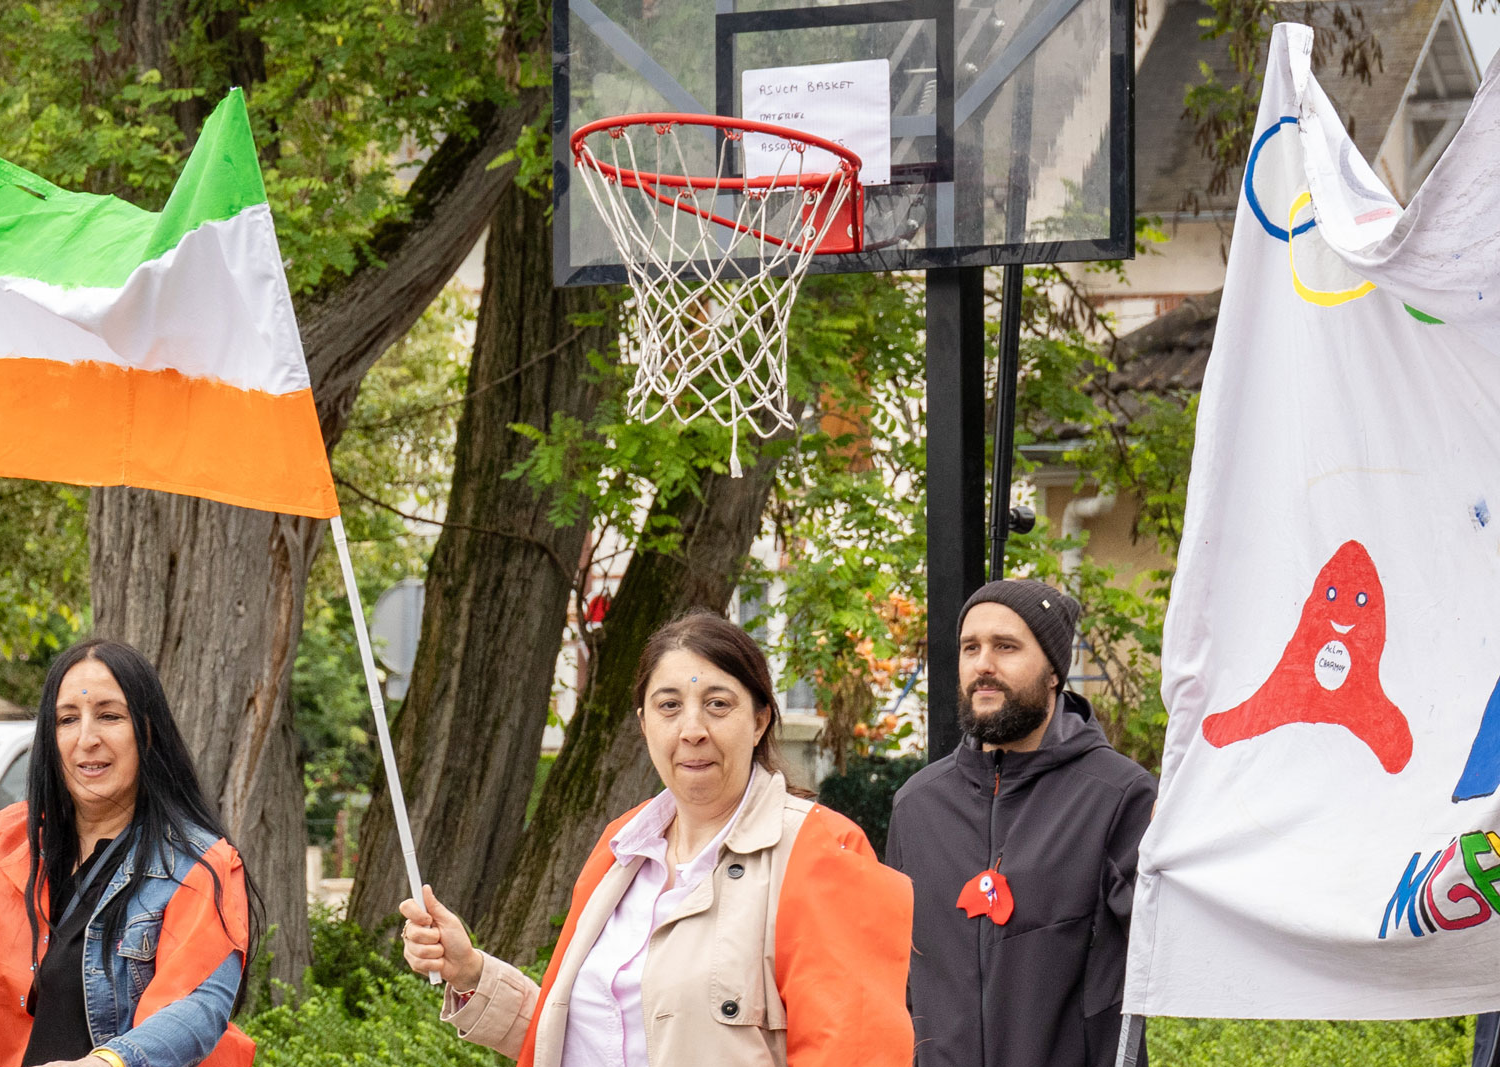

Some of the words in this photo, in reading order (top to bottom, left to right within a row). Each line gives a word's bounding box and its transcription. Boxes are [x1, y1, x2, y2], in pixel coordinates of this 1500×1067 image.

[759, 84, 798, 96] ASUCM
[807, 80, 854, 93] BASKET
[1378, 830, 1500, 939] MIGE
